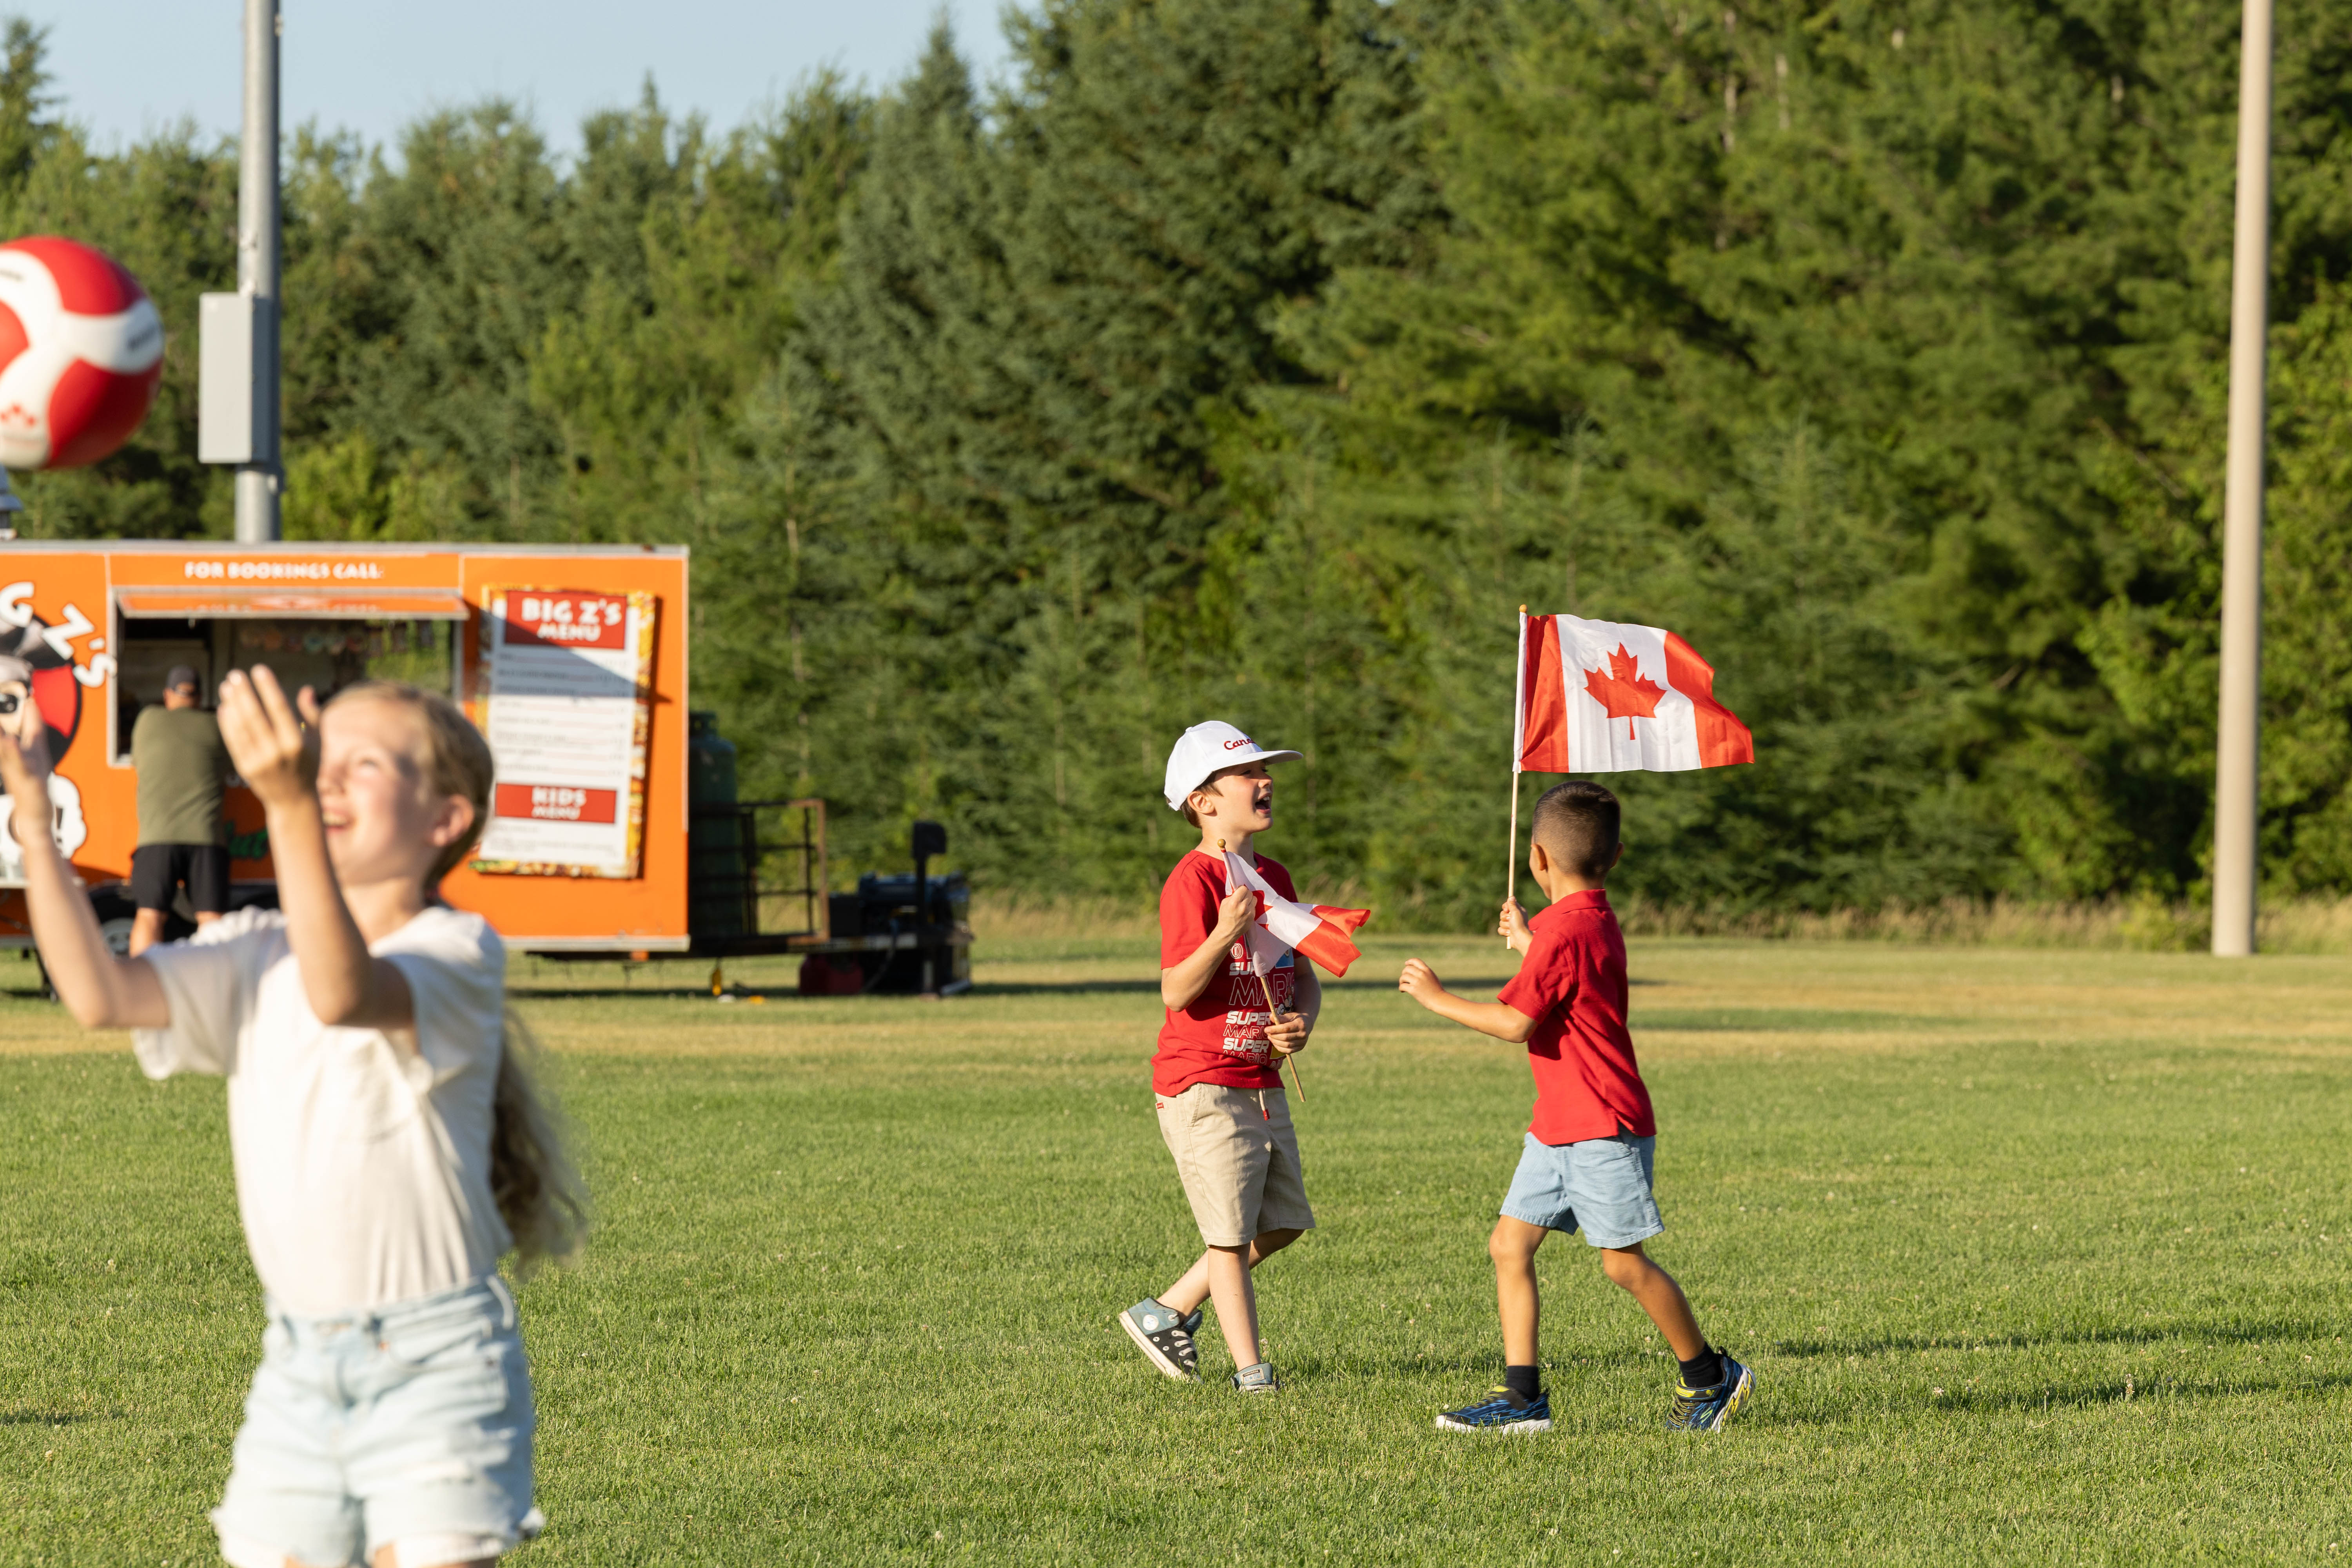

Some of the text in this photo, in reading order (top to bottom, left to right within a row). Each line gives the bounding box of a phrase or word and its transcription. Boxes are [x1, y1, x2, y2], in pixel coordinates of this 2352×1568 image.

[185, 562, 224, 579] FOR
[227, 562, 330, 579] BOOKINGS
[521, 597, 622, 626] BIG Z'S
[537, 622, 601, 642] MENU
[532, 786, 587, 808] KIDS
[531, 806, 581, 820] MENU
[1229, 973, 1294, 1006] MARI
[1225, 1010, 1272, 1025] SUPER
[1223, 1024, 1267, 1039] MARI
[1222, 1037, 1270, 1053] SUPER
